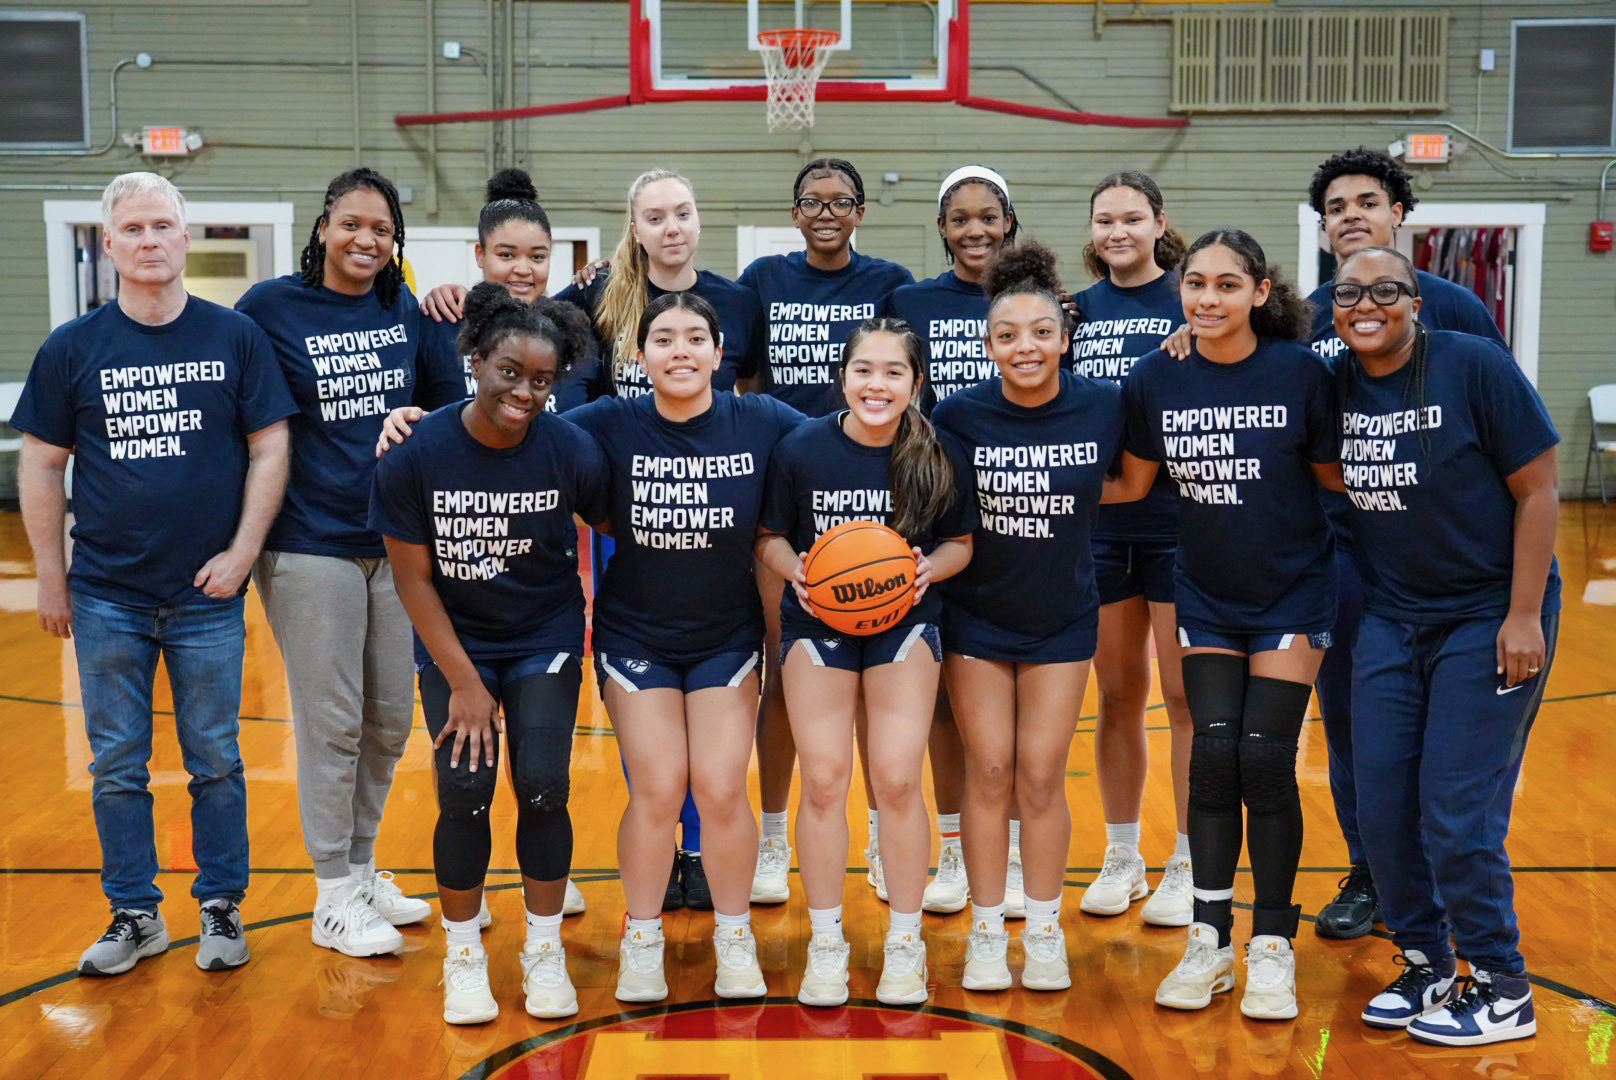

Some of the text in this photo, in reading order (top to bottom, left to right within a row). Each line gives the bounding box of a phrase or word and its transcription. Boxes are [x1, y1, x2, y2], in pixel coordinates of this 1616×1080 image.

[770, 303, 874, 321] EMPOWERED
[304, 324, 407, 355] EMPOWERED
[770, 324, 829, 342] WOMEN
[1072, 318, 1172, 340] EMPOWERED
[1072, 338, 1124, 361] WOMEN
[101, 361, 224, 390] EMPOWERED
[312, 352, 381, 376] WOMEN
[771, 366, 834, 384] WOMEN.
[316, 368, 404, 399] EMPOWER
[103, 388, 177, 414] WOMEN
[320, 394, 390, 421] WOMEN.
[105, 410, 202, 438] EMPOWER
[1163, 406, 1286, 432] EMPOWERED
[110, 436, 185, 459] WOMEN.
[974, 442, 1097, 467] EMPOWERED
[1164, 433, 1234, 457] WOMEN
[632, 452, 754, 479] EMPOWERED
[1167, 459, 1261, 480] EMPOWER
[1343, 463, 1418, 487] EMPOWER
[632, 481, 708, 504] WOMEN
[977, 470, 1049, 492] WOMEN
[434, 490, 559, 513] EMPOWERED
[979, 495, 1075, 515] EMPOWER
[434, 517, 508, 538] WOMEN
[632, 505, 734, 529] EMPOWER
[980, 515, 1054, 538] WOMEN.
[434, 538, 532, 560] EMPOWER
[632, 528, 712, 549] WOMEN.
[439, 557, 509, 580] WOMEN.
[831, 572, 908, 604] Wilson
